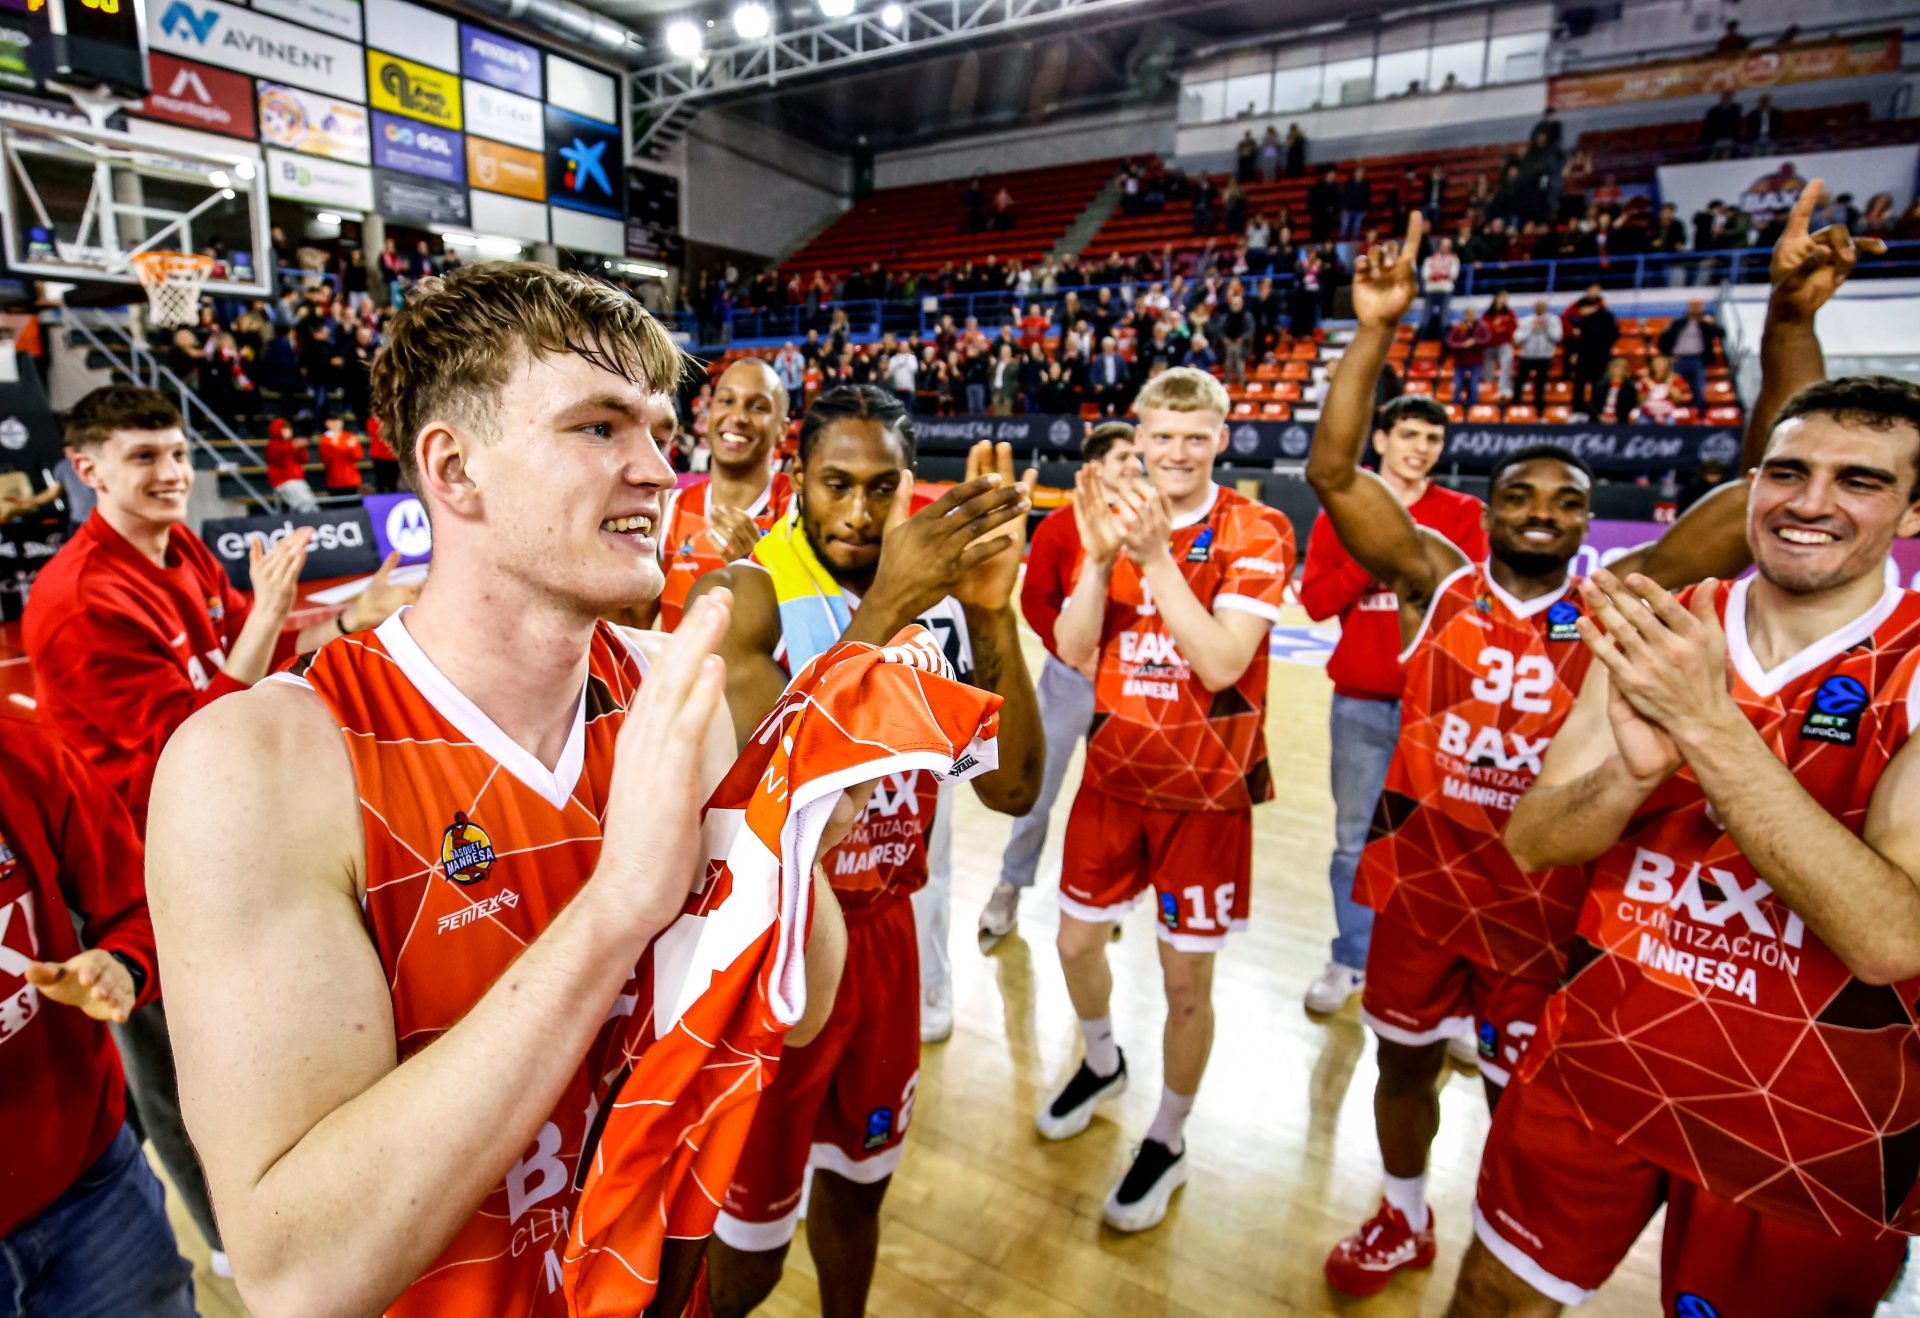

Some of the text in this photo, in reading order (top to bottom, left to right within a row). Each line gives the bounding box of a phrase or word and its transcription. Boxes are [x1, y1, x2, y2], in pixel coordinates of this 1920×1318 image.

[221, 27, 335, 75] AVINENT
[217, 520, 364, 560] endsa
[1136, 576, 1157, 616] 1
[1120, 631, 1190, 667] BAX
[1471, 645, 1554, 714] 32
[1438, 712, 1552, 776] BAX
[1442, 775, 1521, 812] MANRES
[446, 847, 495, 877] MANRESA
[450, 841, 480, 860] BASQUET
[437, 893, 502, 936] PENTEX
